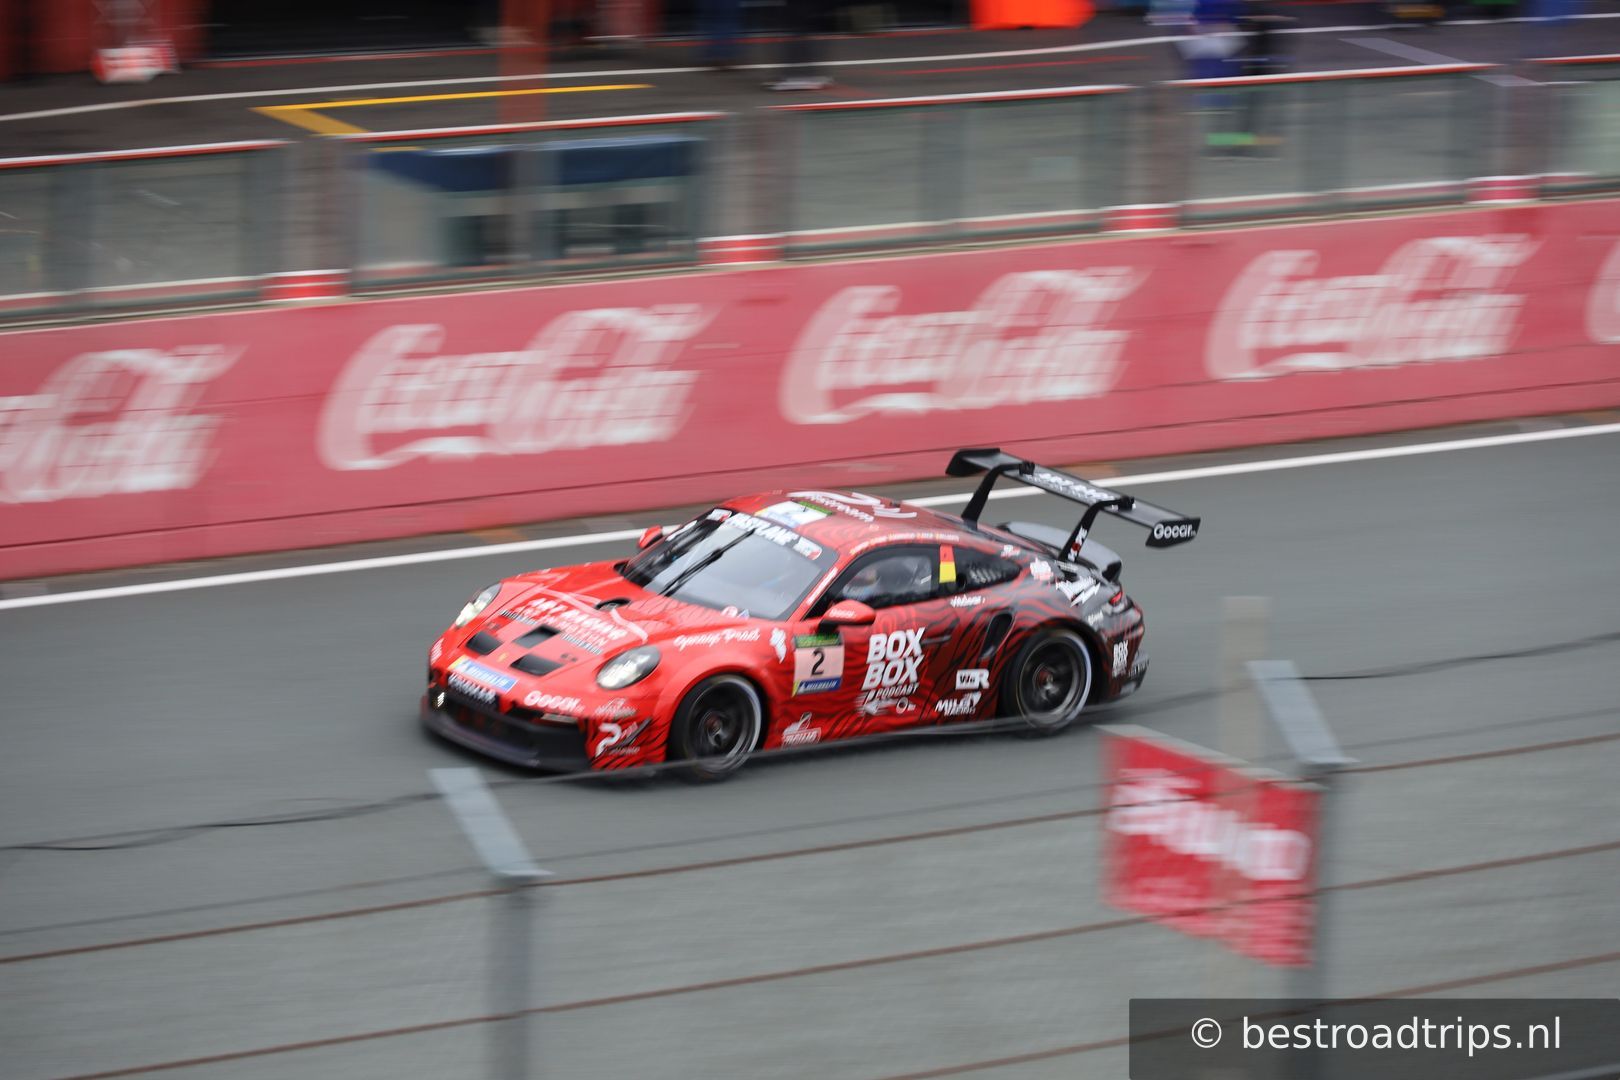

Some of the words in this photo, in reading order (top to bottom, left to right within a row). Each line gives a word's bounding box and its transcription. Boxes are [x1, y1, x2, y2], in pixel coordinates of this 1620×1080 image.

[866, 627, 925, 664] BOX
[811, 648, 825, 677] 2
[861, 655, 924, 691] BOX
[807, 680, 838, 690] MICHELIN
[876, 682, 920, 700] PODCAST
